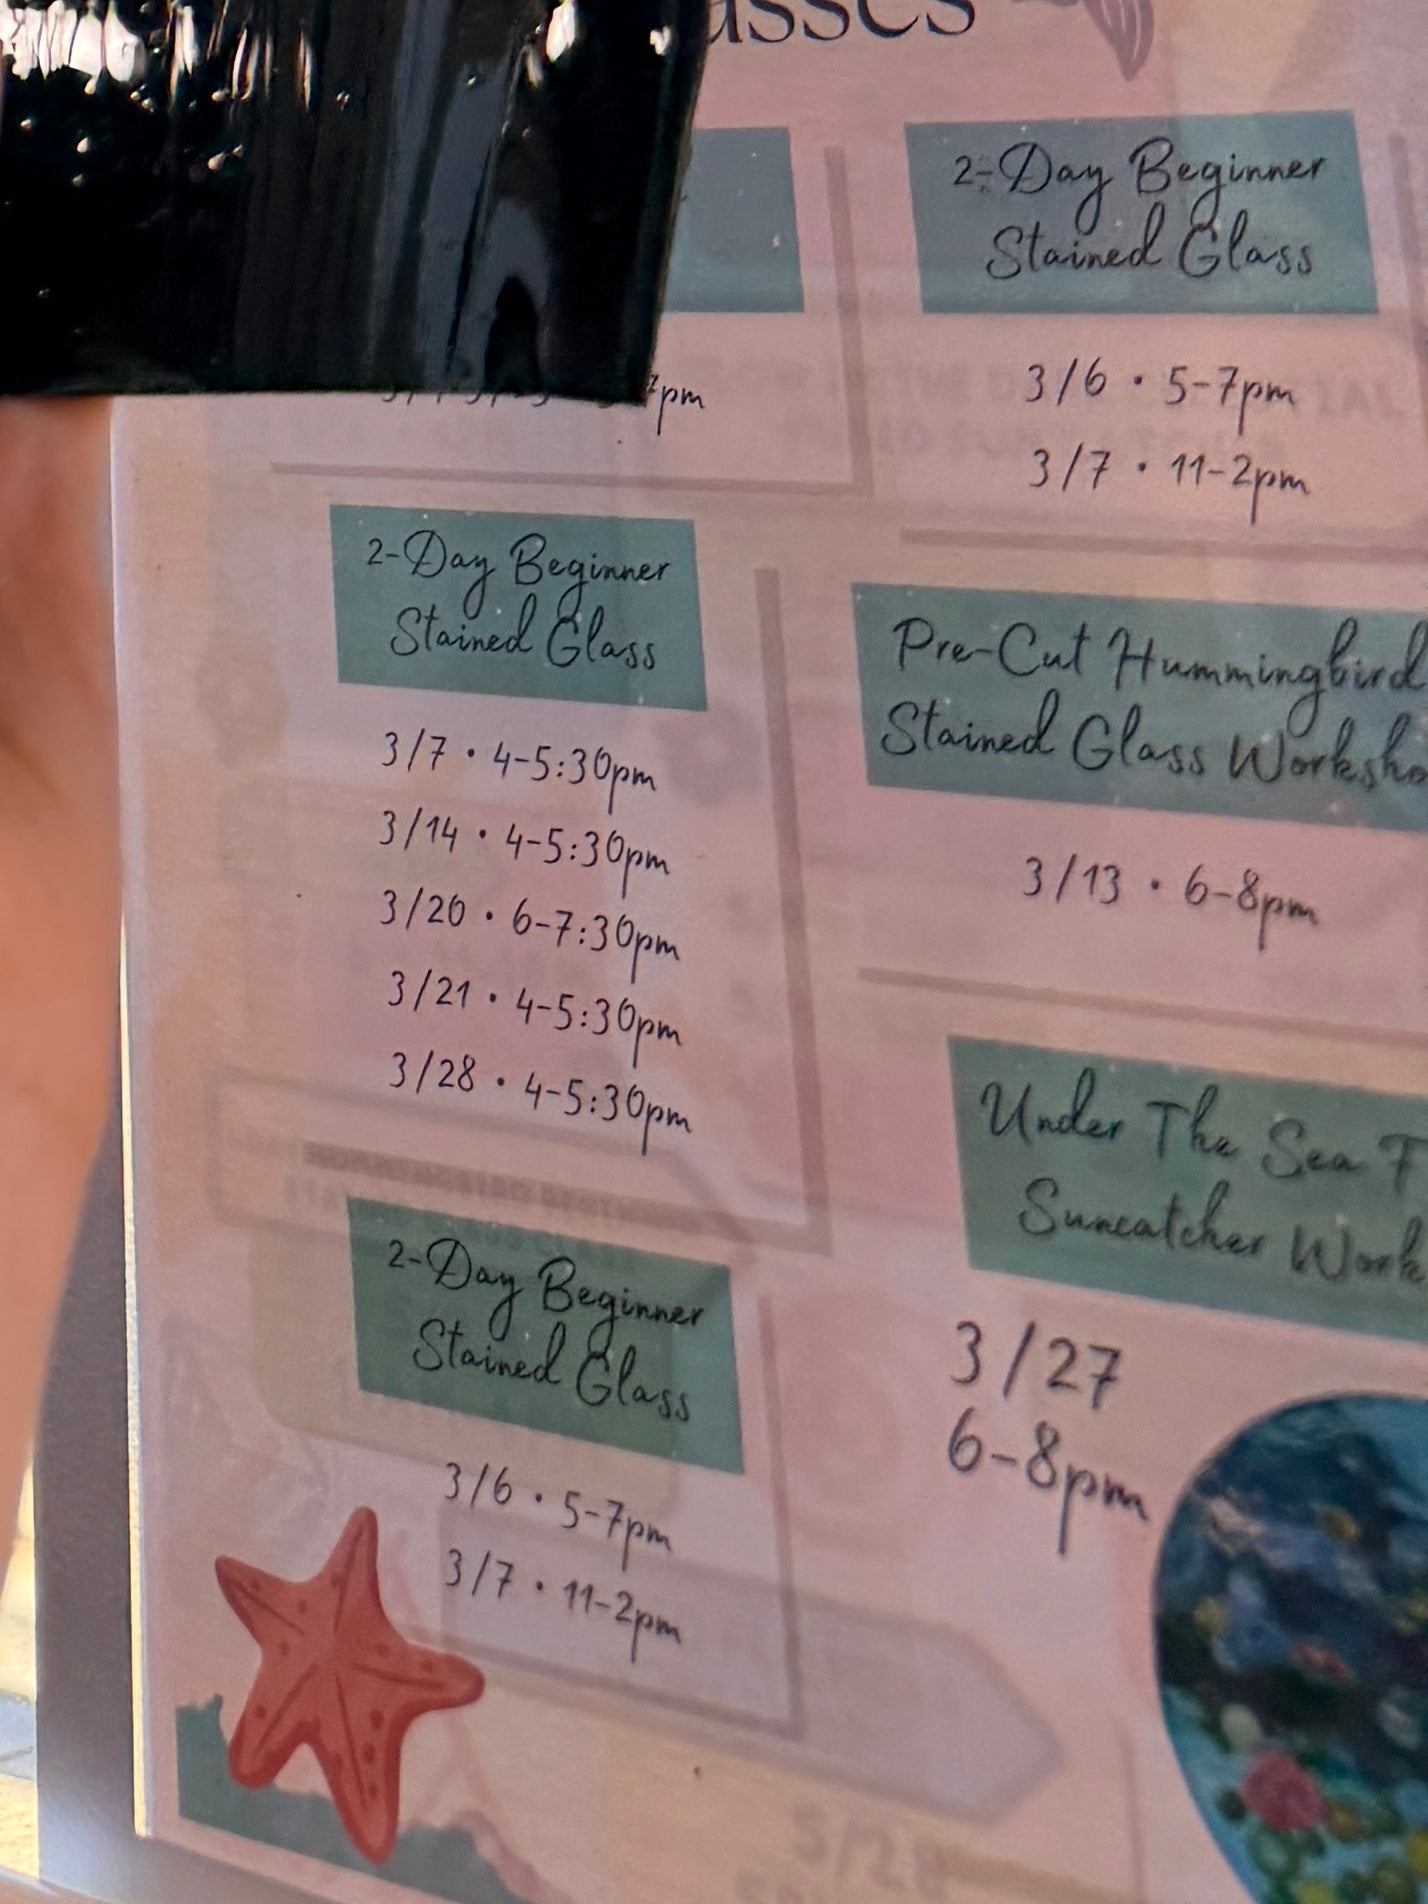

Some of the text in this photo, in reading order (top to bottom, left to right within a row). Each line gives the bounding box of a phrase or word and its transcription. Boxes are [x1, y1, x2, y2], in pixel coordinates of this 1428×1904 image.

[954, 136, 1328, 234] 2-Day Beginner
[986, 203, 1315, 279] Stained Glass
[1025, 358, 1108, 405] 3/6
[1165, 365, 1297, 436] 5-7pm
[1029, 443, 1312, 527] 3/7 11-2pm
[367, 530, 672, 621] 2-Day Beginner
[390, 593, 657, 671] Stained Glass
[892, 616, 1428, 738] Pre-Cut Hummingbird
[382, 728, 657, 815] 3/7 4-5:30pm
[881, 688, 1062, 756] Stained
[1072, 703, 1206, 772] Glass
[379, 807, 671, 899] 3/14 4-5:30pm
[380, 887, 681, 984] 3/20 6-7:30pm
[1022, 852, 1320, 953] 3/13 6-8pm
[388, 968, 683, 1069] 3/21 4-5:30pm
[389, 1050, 693, 1156] 3/28 4-5:30pm
[980, 1066, 1126, 1147] Under
[1145, 1083, 1243, 1161] The
[1261, 1117, 1367, 1179] Sea
[1018, 1177, 1267, 1259] Suncatcher
[388, 1238, 705, 1354] 2-Day Beginner
[413, 1318, 690, 1423] Stained Glass
[950, 1319, 1124, 1411] 3/27
[445, 1461, 674, 1573] 3/6 5-7pm
[947, 1406, 1150, 1558] 6-8pm
[445, 1548, 684, 1664] 3/7 11-2pm
